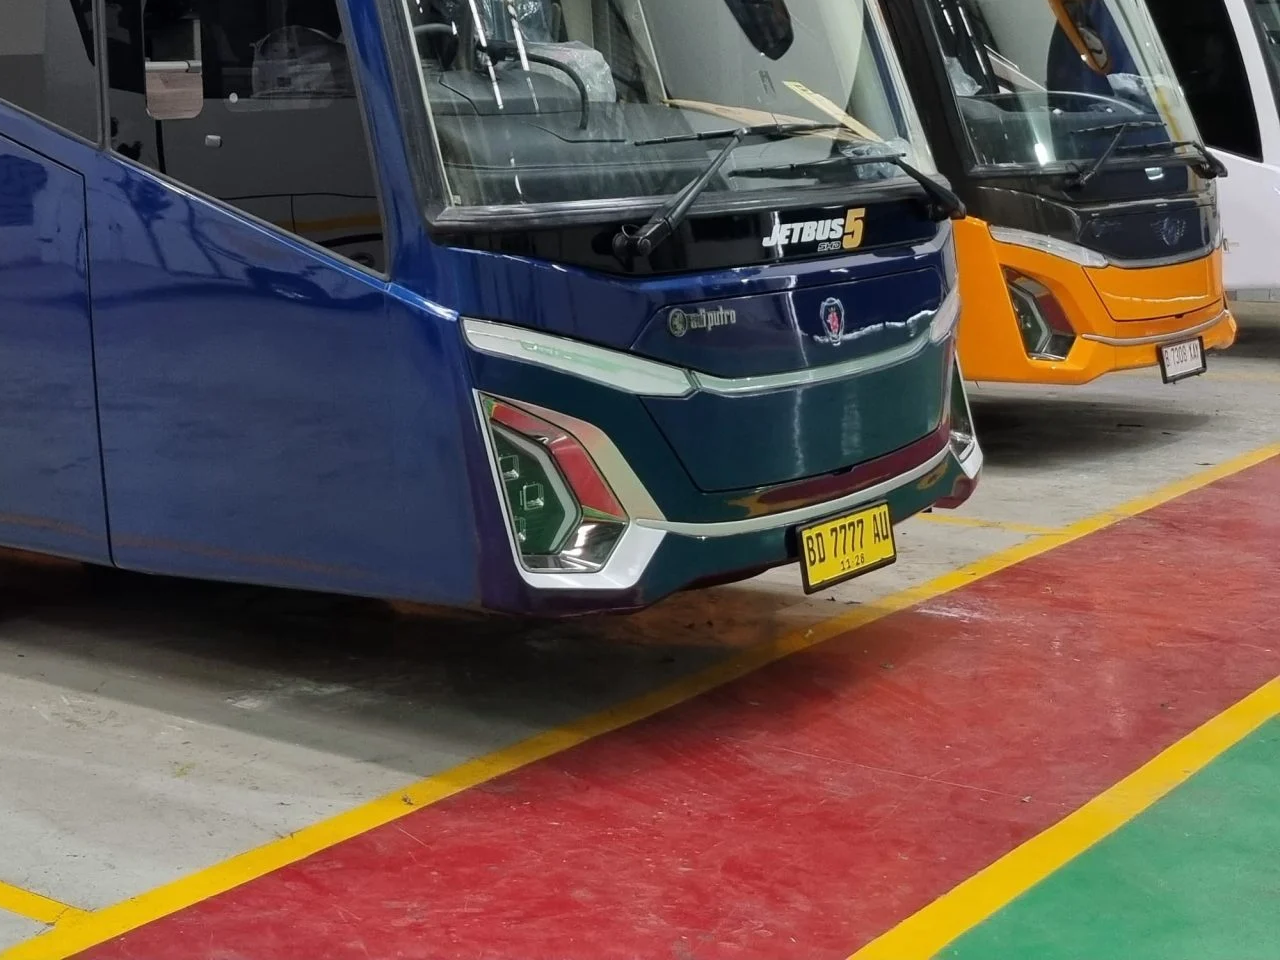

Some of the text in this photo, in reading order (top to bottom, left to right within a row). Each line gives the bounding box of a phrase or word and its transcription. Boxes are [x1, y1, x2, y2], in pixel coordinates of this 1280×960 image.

[762, 207, 866, 249] JETBUS 5
[805, 510, 889, 567] BD 7777 AU
